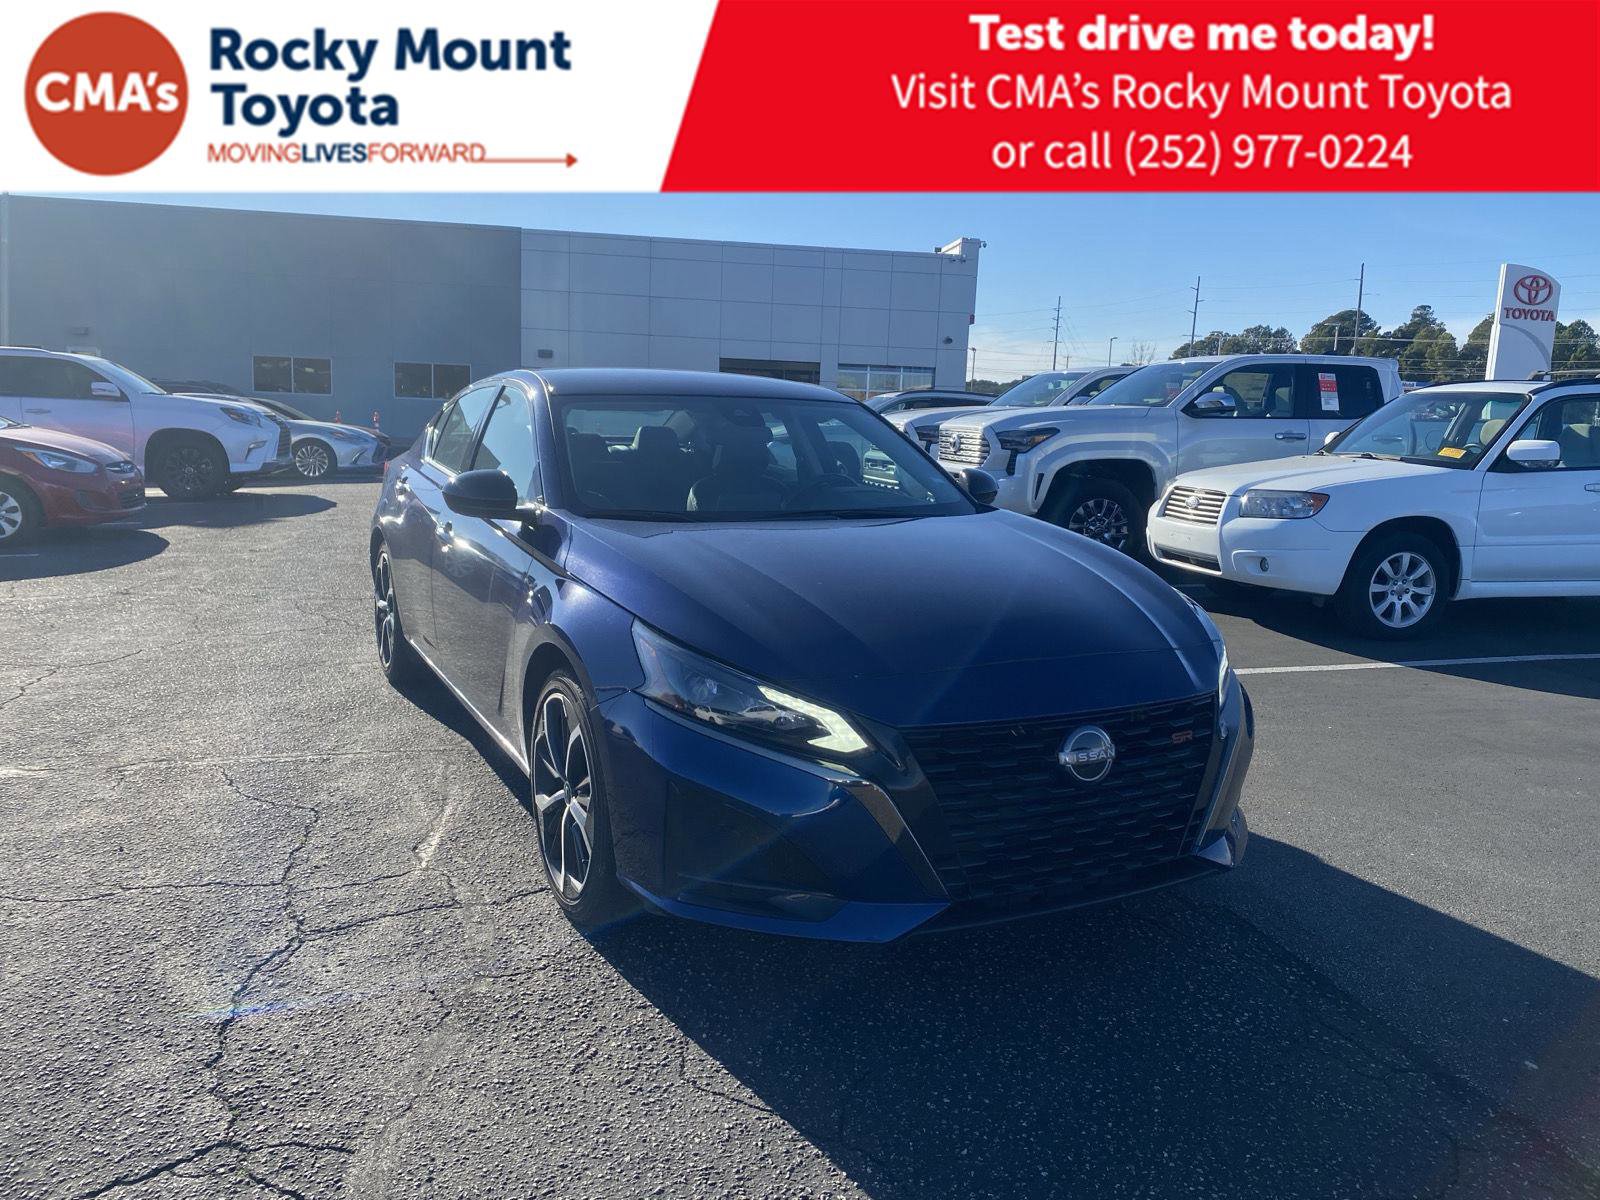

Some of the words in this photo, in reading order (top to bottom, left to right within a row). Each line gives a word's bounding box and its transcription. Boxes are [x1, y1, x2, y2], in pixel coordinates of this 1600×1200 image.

[1504, 307, 1556, 321] TOYOTA
[1171, 730, 1193, 745] SR
[1060, 744, 1115, 765] NISSAN
